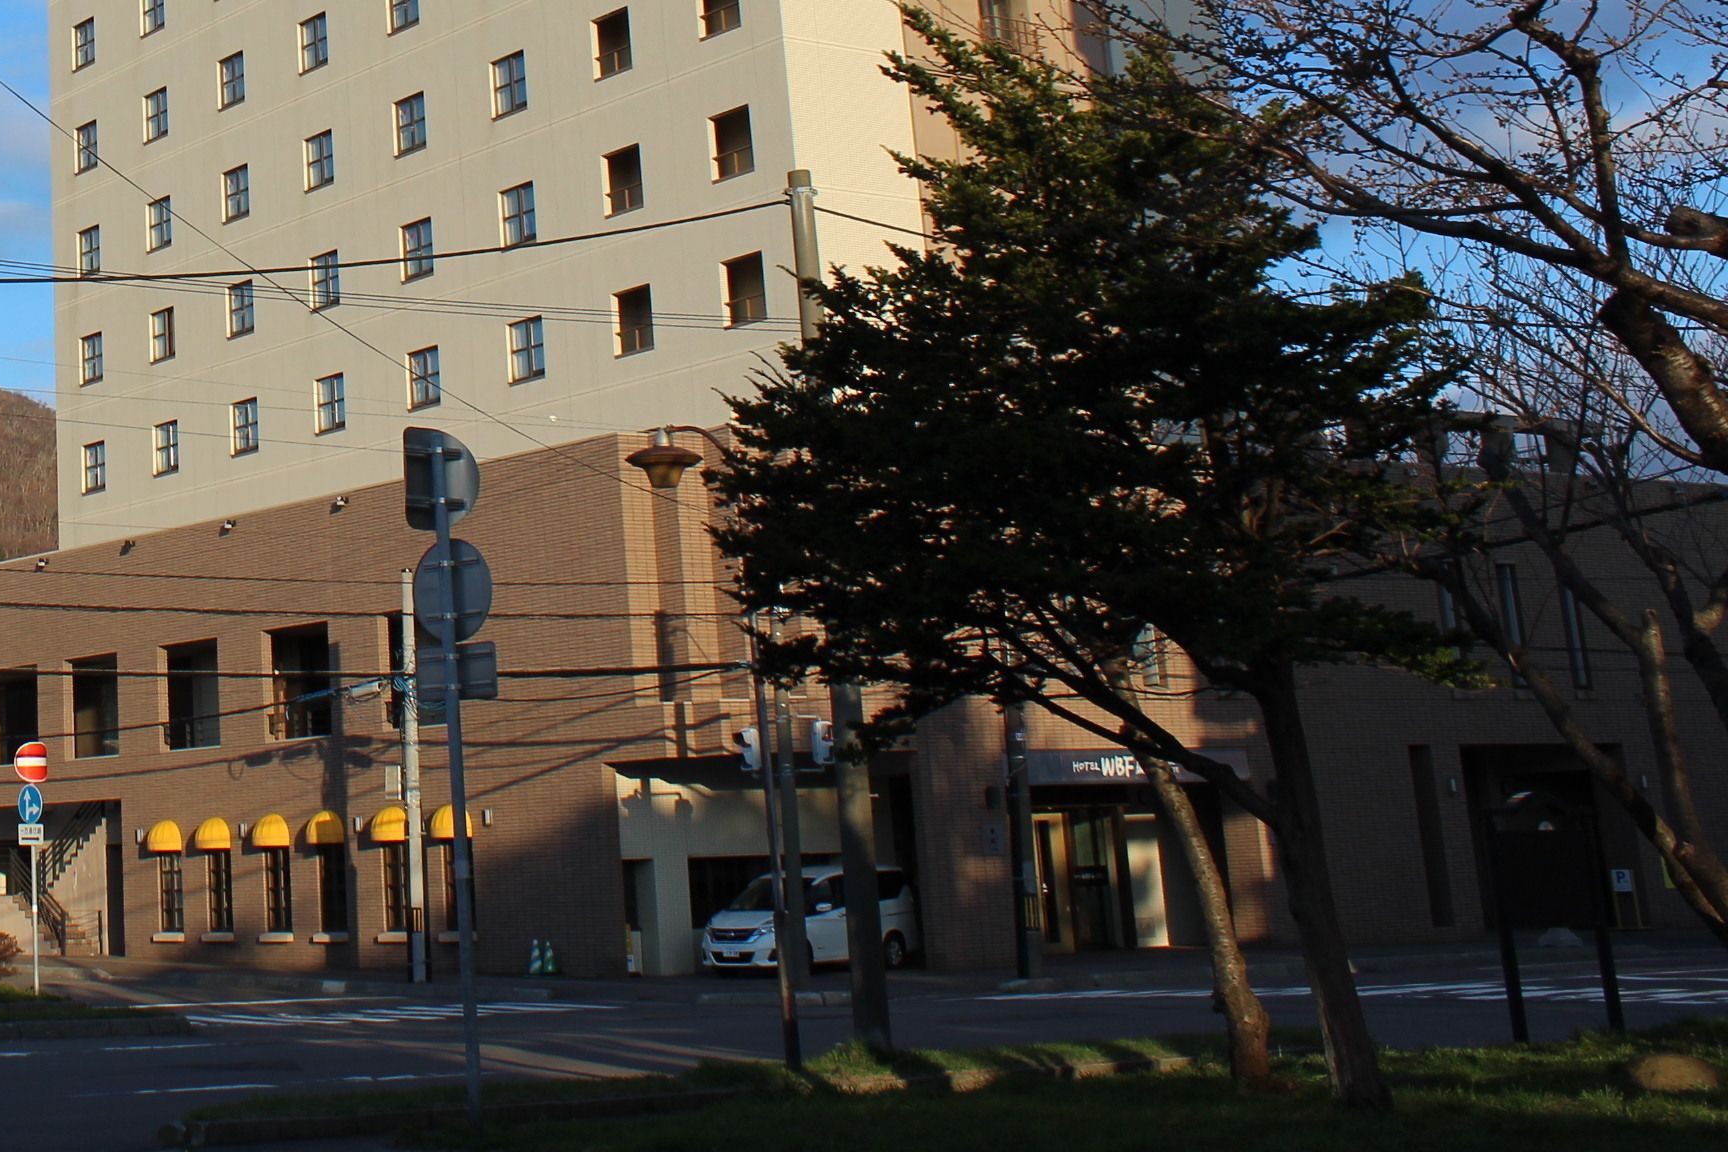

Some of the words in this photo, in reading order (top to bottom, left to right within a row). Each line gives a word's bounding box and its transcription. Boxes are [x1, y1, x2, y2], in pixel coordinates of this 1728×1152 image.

[1072, 760, 1101, 773] HOTEL
[1100, 755, 1135, 778] WBF
[1615, 871, 1626, 884] P
